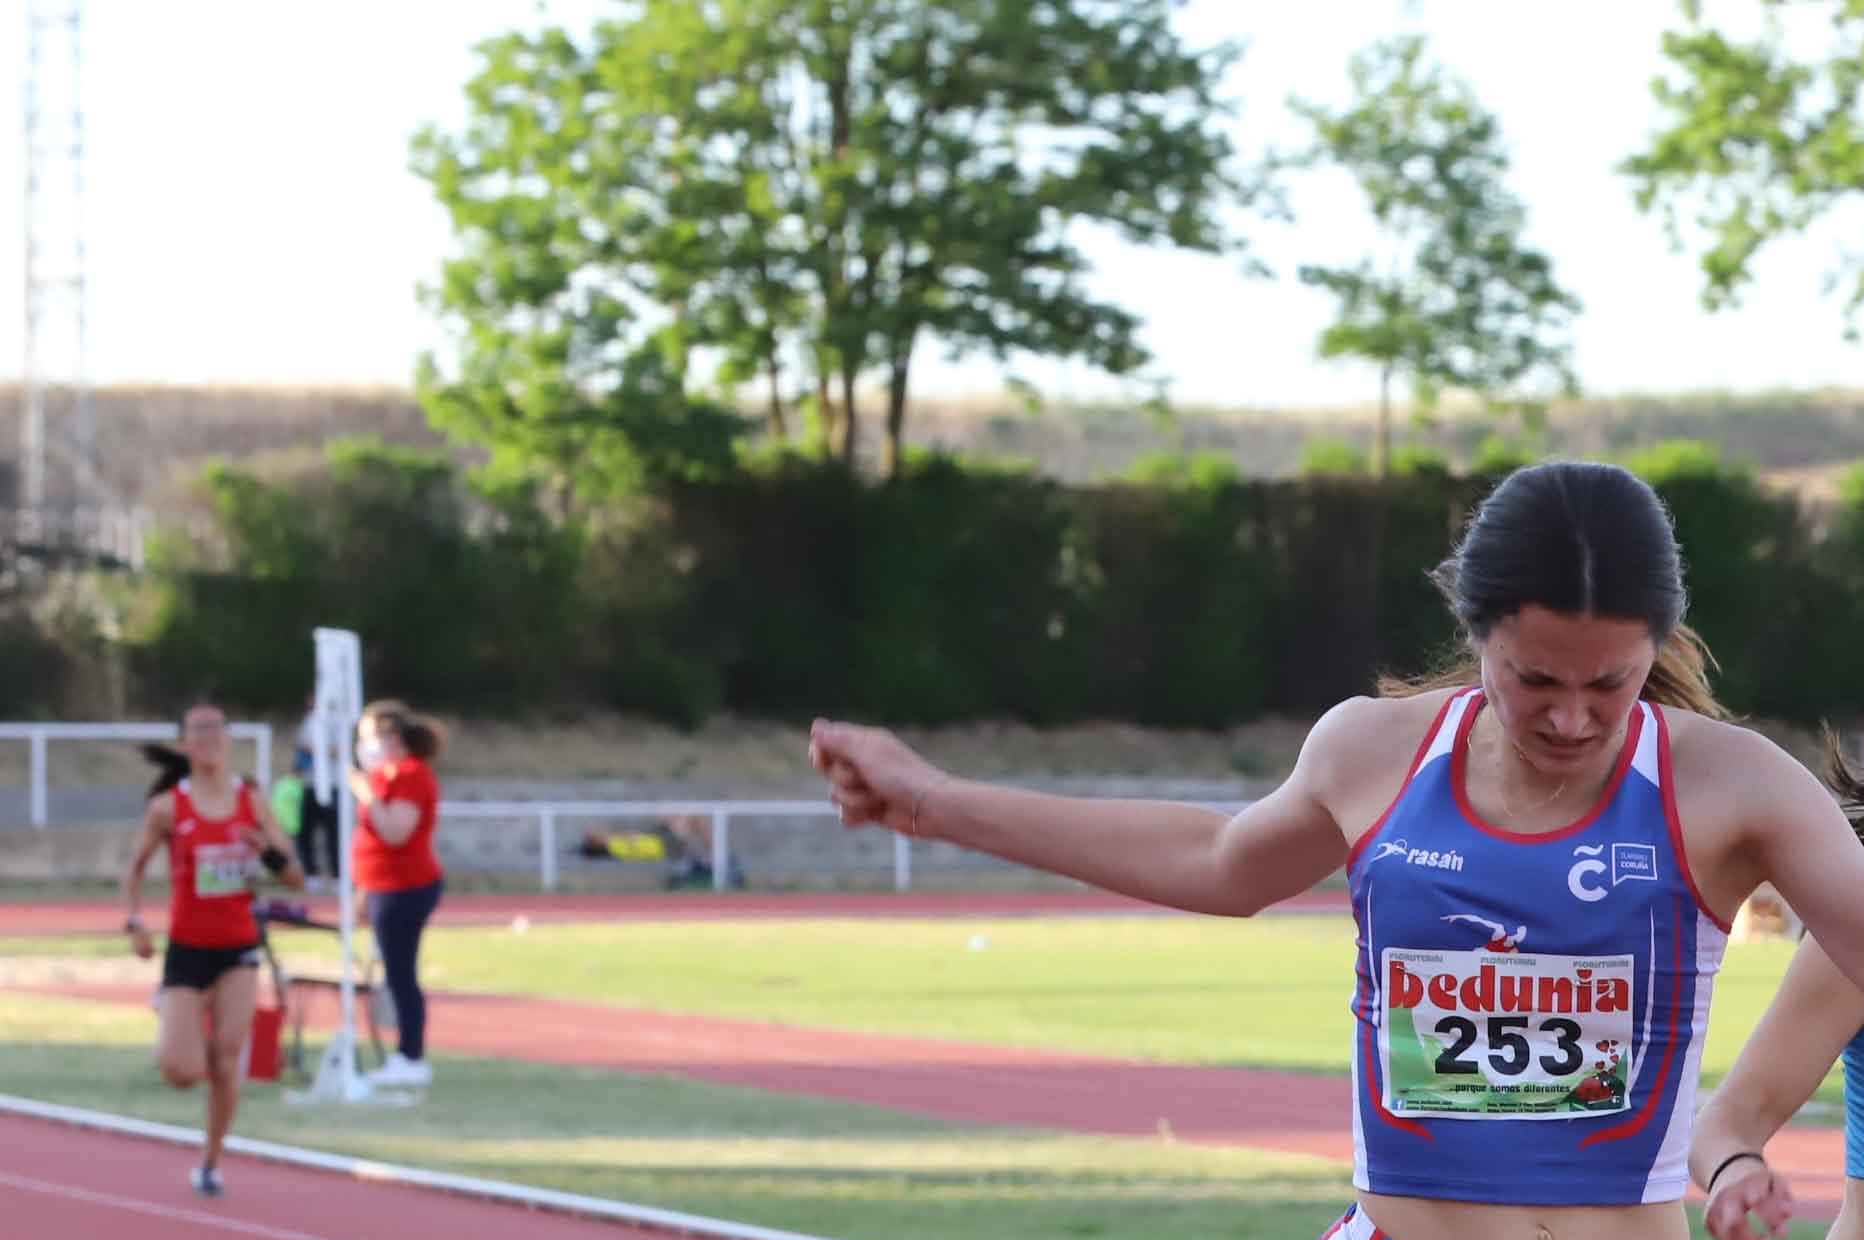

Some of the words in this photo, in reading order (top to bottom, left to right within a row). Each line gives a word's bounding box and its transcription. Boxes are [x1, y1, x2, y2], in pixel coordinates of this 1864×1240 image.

[1406, 848, 1464, 872] rasán
[1389, 960, 1629, 1013] bedunia
[1433, 1015, 1584, 1077] 253
